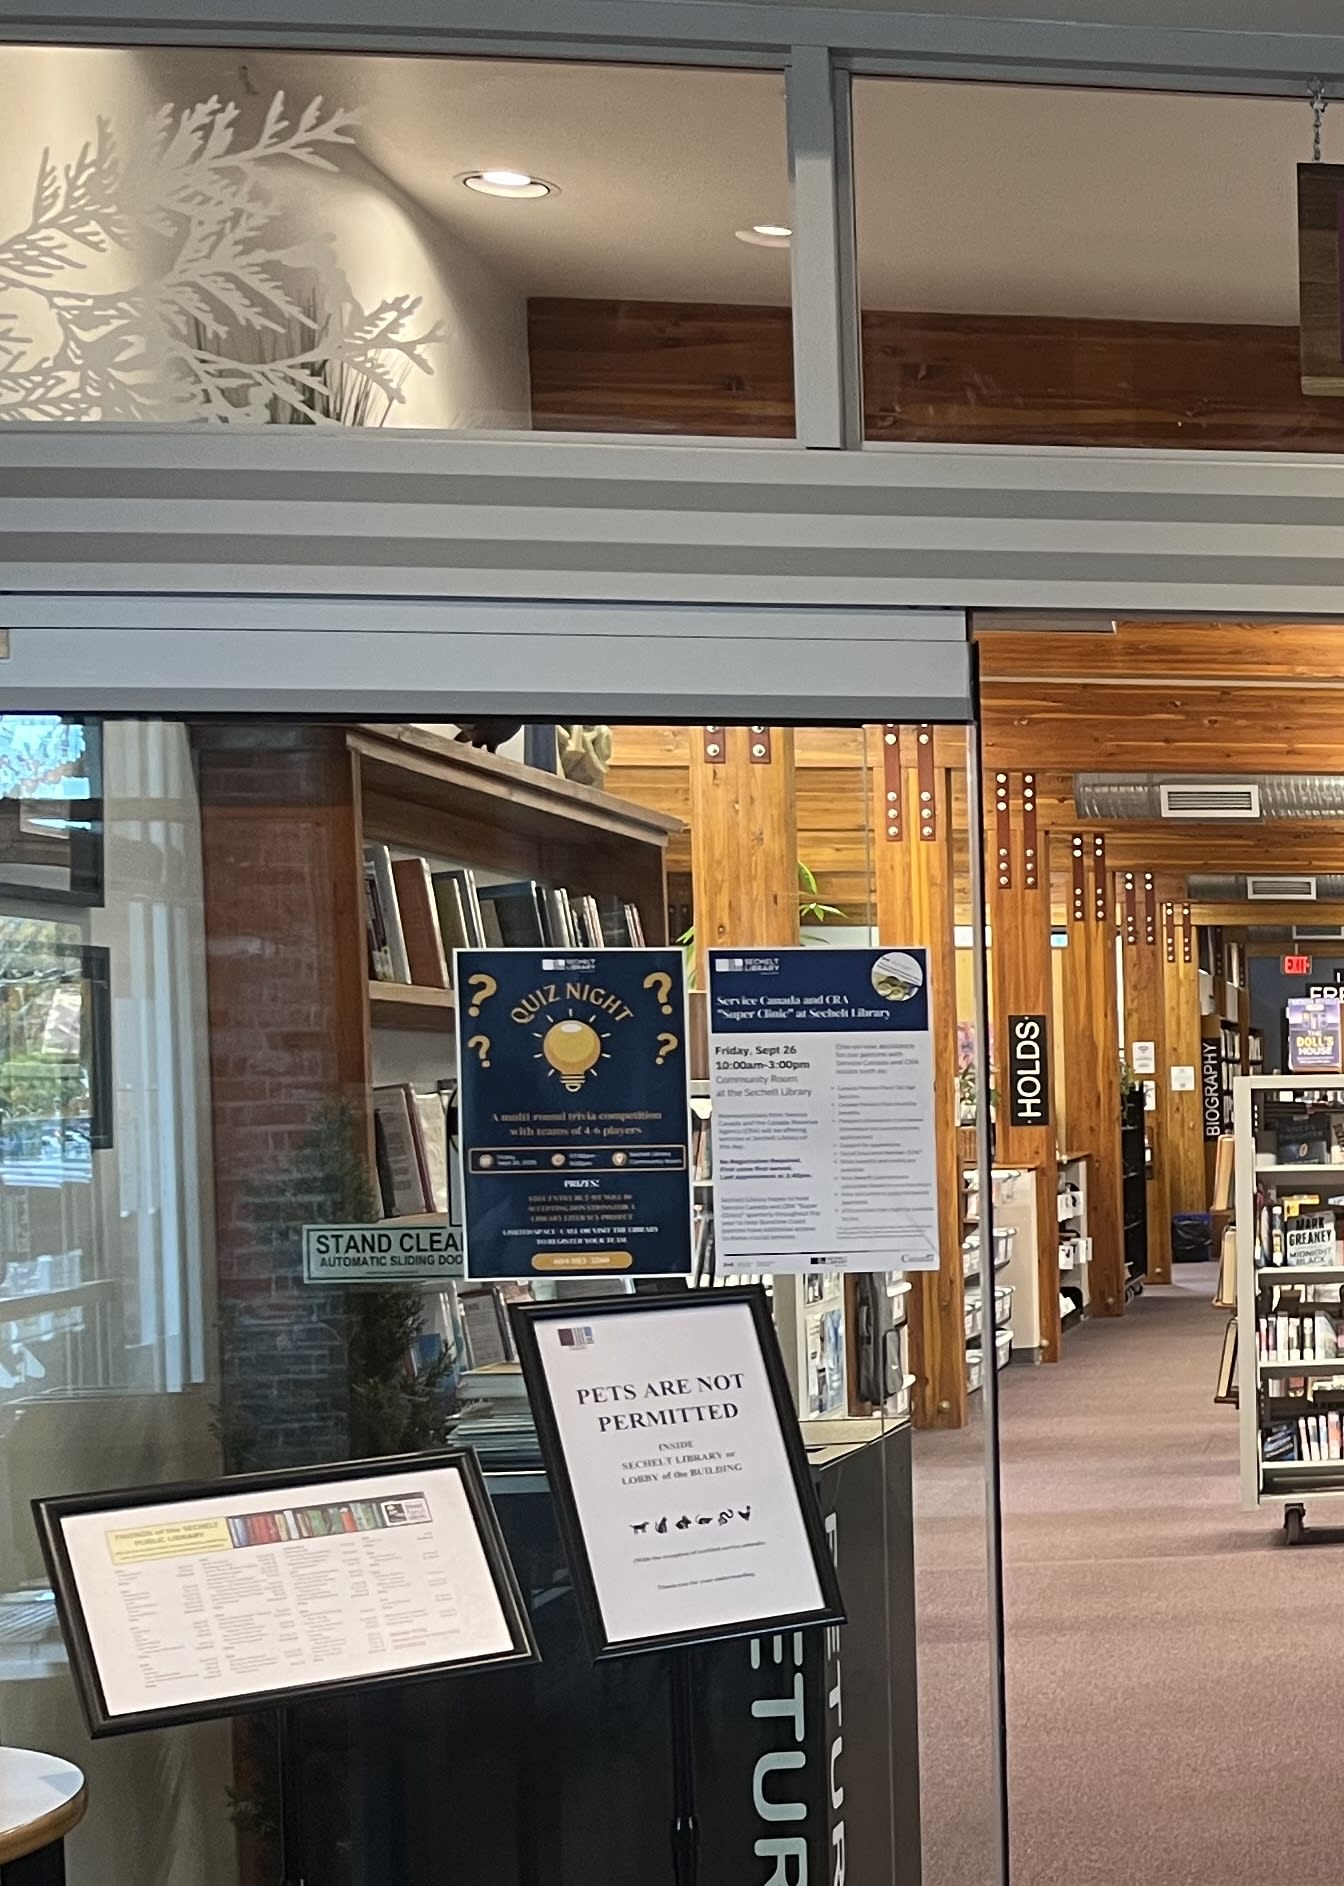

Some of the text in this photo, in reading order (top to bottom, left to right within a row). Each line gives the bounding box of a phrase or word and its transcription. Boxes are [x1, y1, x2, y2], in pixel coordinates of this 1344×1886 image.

[1286, 957, 1310, 972] EXIT
[511, 982, 635, 1024] QUIZ NIGHT
[717, 996, 758, 1005] Service
[760, 995, 801, 1005] Canada
[803, 995, 824, 1005] and
[795, 1010, 807, 1018] at
[808, 1008, 849, 1018] Sechelt
[851, 1007, 890, 1019] Library
[1296, 1036, 1334, 1048] DOLL'S
[715, 1045, 797, 1056] Friday, Sept 26
[1299, 1047, 1333, 1056] HOUSE
[1015, 1020, 1042, 1118] HOLDS
[715, 1075, 798, 1085] Community Room
[716, 1088, 813, 1098] at the Sechelt Library
[1204, 1042, 1221, 1137] BIOGRAPHY
[1296, 1217, 1325, 1230] MARK
[316, 1232, 464, 1254] STAND CLEA
[1289, 1230, 1332, 1246] GREANEY
[320, 1254, 464, 1267] AUTOMATIC SLIDING DOO
[577, 1373, 745, 1405] PETS ARE NOT
[598, 1402, 739, 1432] PERMITTED
[658, 1440, 694, 1452] INSIDE
[622, 1457, 672, 1471] SECHELT
[675, 1451, 723, 1464] LIBRARY
[622, 1463, 743, 1487] LOBBY of the BUILDING
